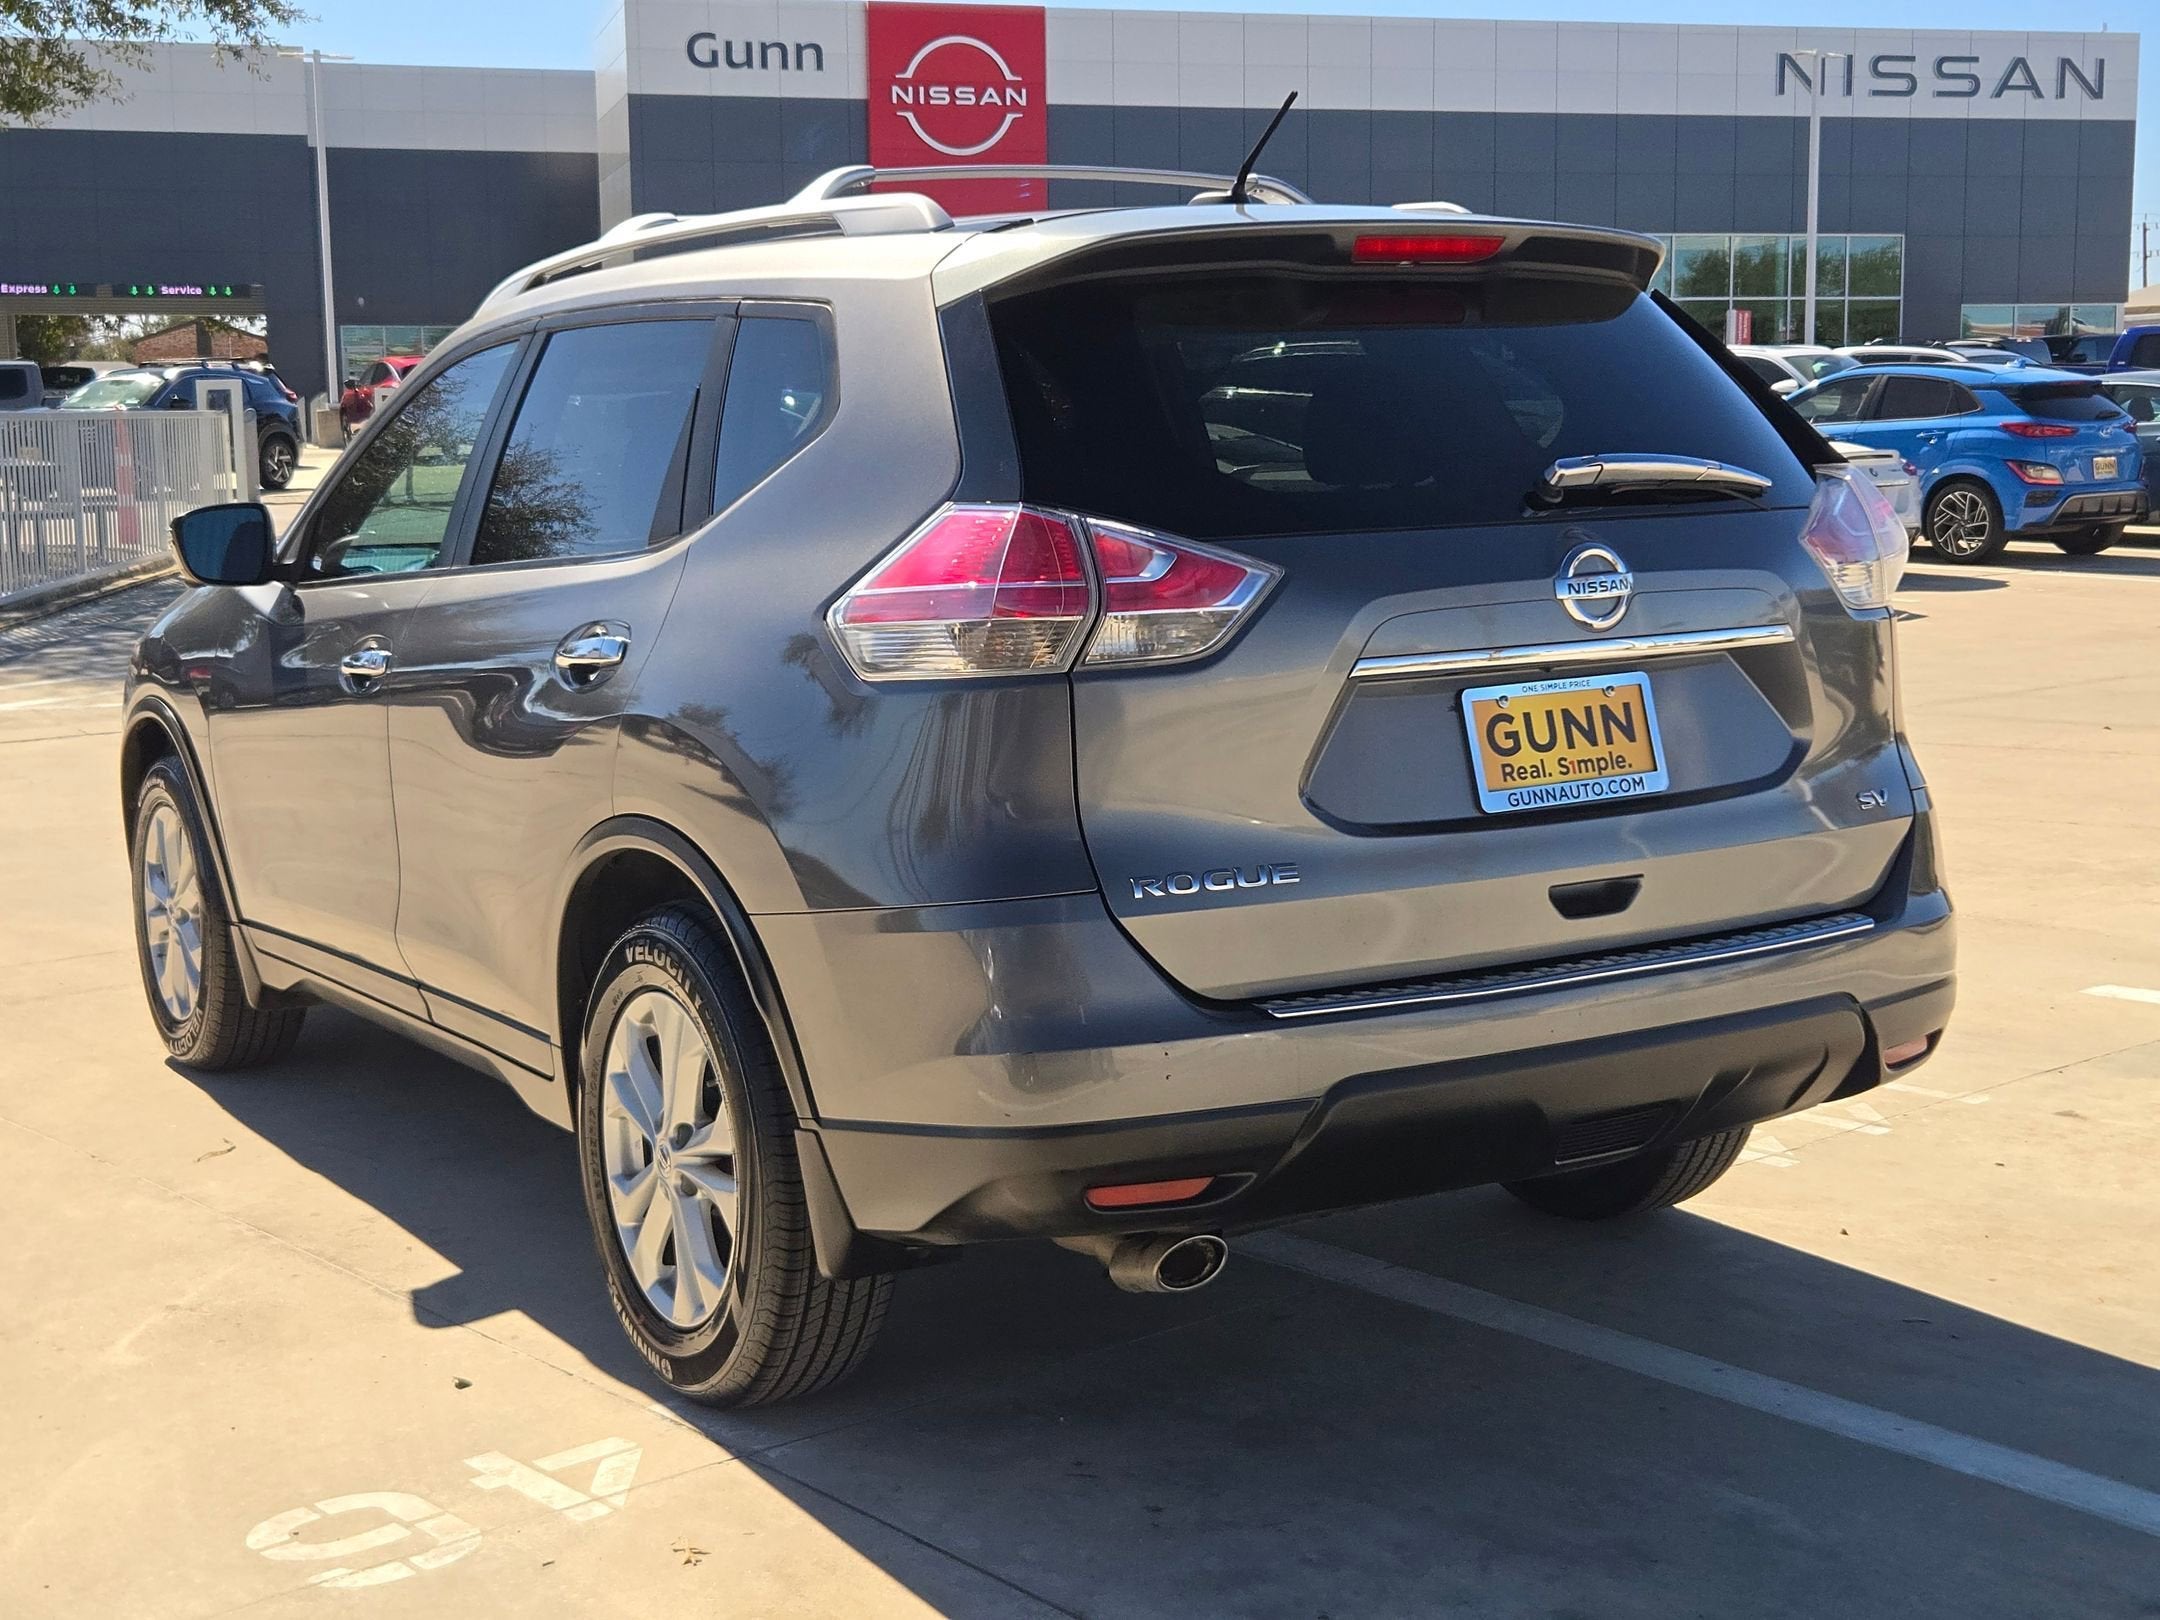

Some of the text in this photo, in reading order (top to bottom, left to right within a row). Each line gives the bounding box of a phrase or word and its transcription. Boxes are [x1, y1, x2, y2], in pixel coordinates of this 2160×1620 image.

[686, 31, 824, 72] Gunn
[1776, 52, 2105, 100] NISSAN
[891, 85, 1027, 106] NISSAN
[0, 283, 48, 295] Express
[161, 285, 203, 295] Service
[1567, 578, 1630, 595] NISSAN
[1521, 680, 1592, 693] ONE SIMPLE PRICE
[1486, 702, 1637, 757] GUNN
[1501, 759, 1553, 783] Real.
[1508, 776, 1645, 807] GUNNAUTO.COM
[1856, 788, 1888, 810] SV
[1129, 862, 1300, 899] ROGUE
[626, 938, 706, 1010] VELOCITY
[169, 1006, 203, 1055] VELOCITY
